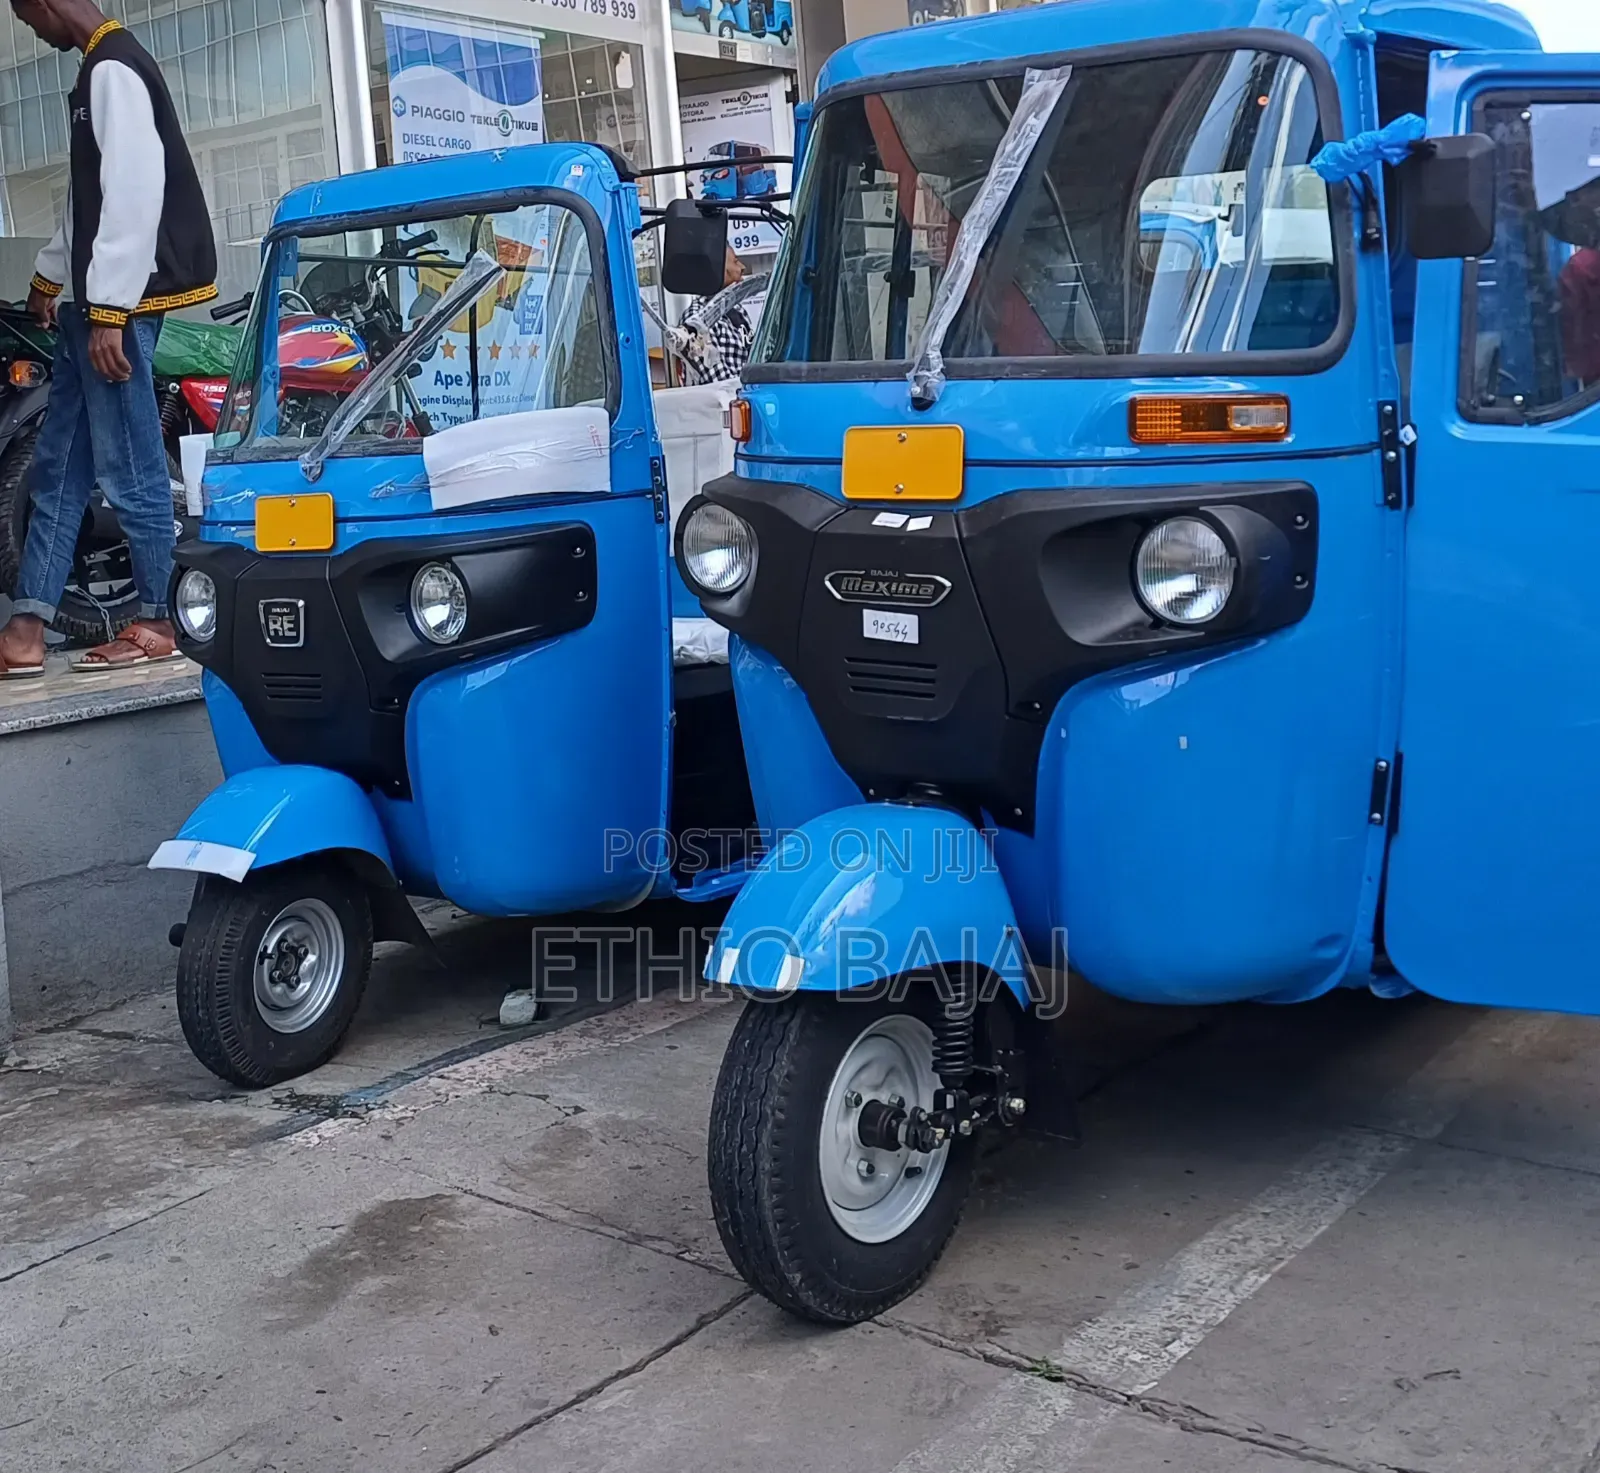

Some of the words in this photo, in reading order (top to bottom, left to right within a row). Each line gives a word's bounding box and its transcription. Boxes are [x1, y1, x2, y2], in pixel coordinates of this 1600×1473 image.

[611, 1, 636, 20] 939
[411, 104, 465, 123] PIAGGIO
[470, 114, 500, 127] TEKLE
[402, 132, 437, 147] DIESEL
[438, 136, 472, 151] CARGO
[734, 234, 760, 249] 939
[433, 370, 463, 389] Ape
[494, 370, 511, 387] DX
[871, 569, 899, 577] BAJAJ
[268, 615, 297, 637] RE
